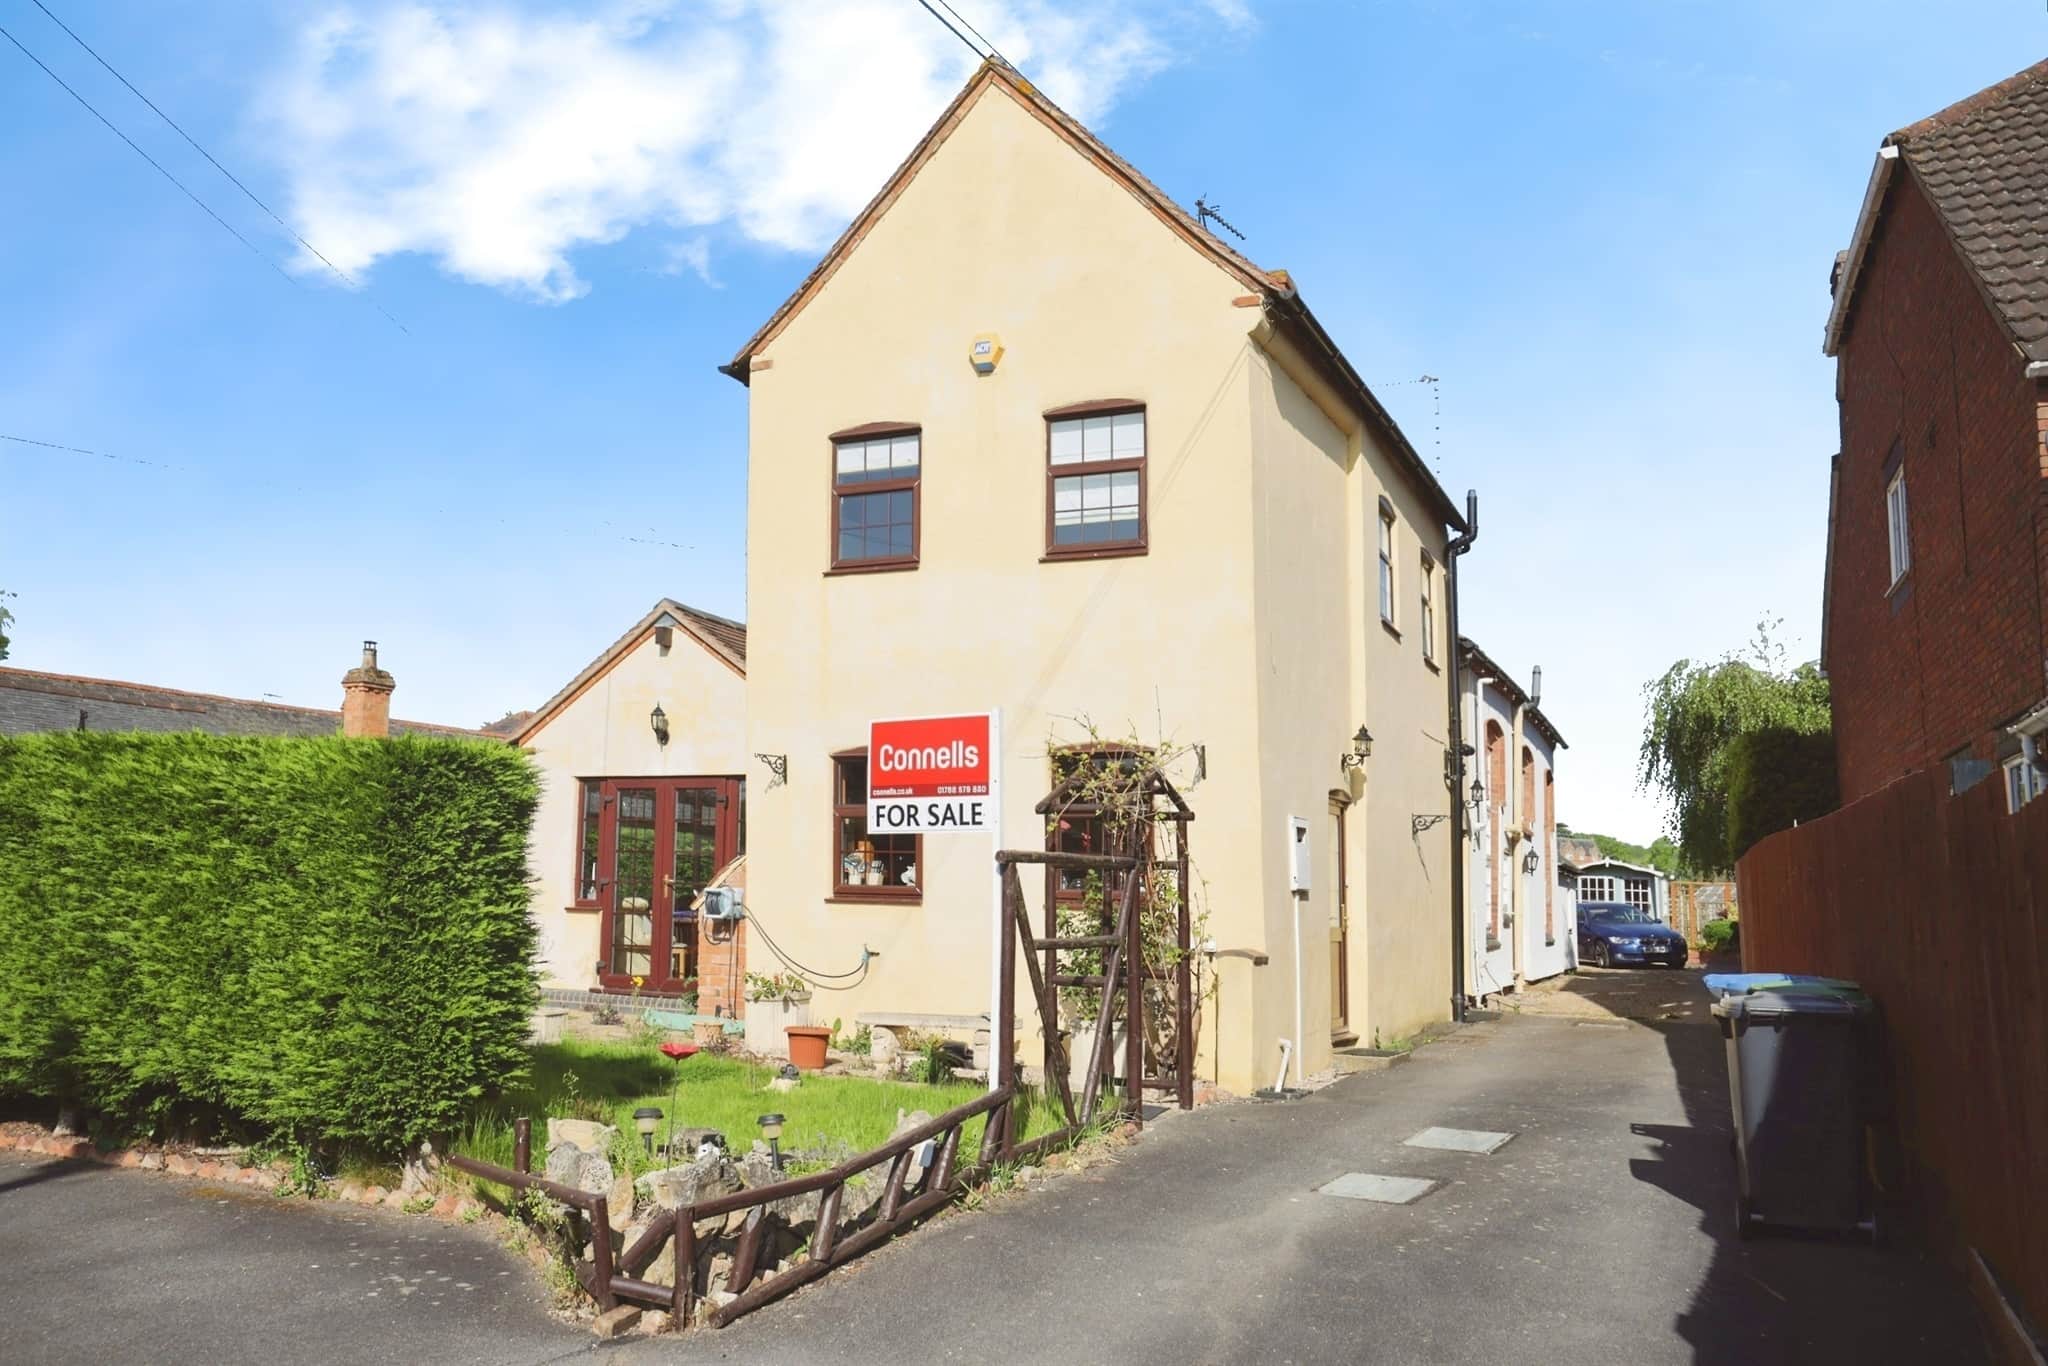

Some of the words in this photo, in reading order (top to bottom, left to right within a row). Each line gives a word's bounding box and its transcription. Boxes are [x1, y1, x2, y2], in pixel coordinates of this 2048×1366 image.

[879, 740, 979, 772] Connells
[872, 788, 913, 796] connells.co.uk
[876, 805, 920, 828] FOR
[928, 802, 983, 826] SALE
